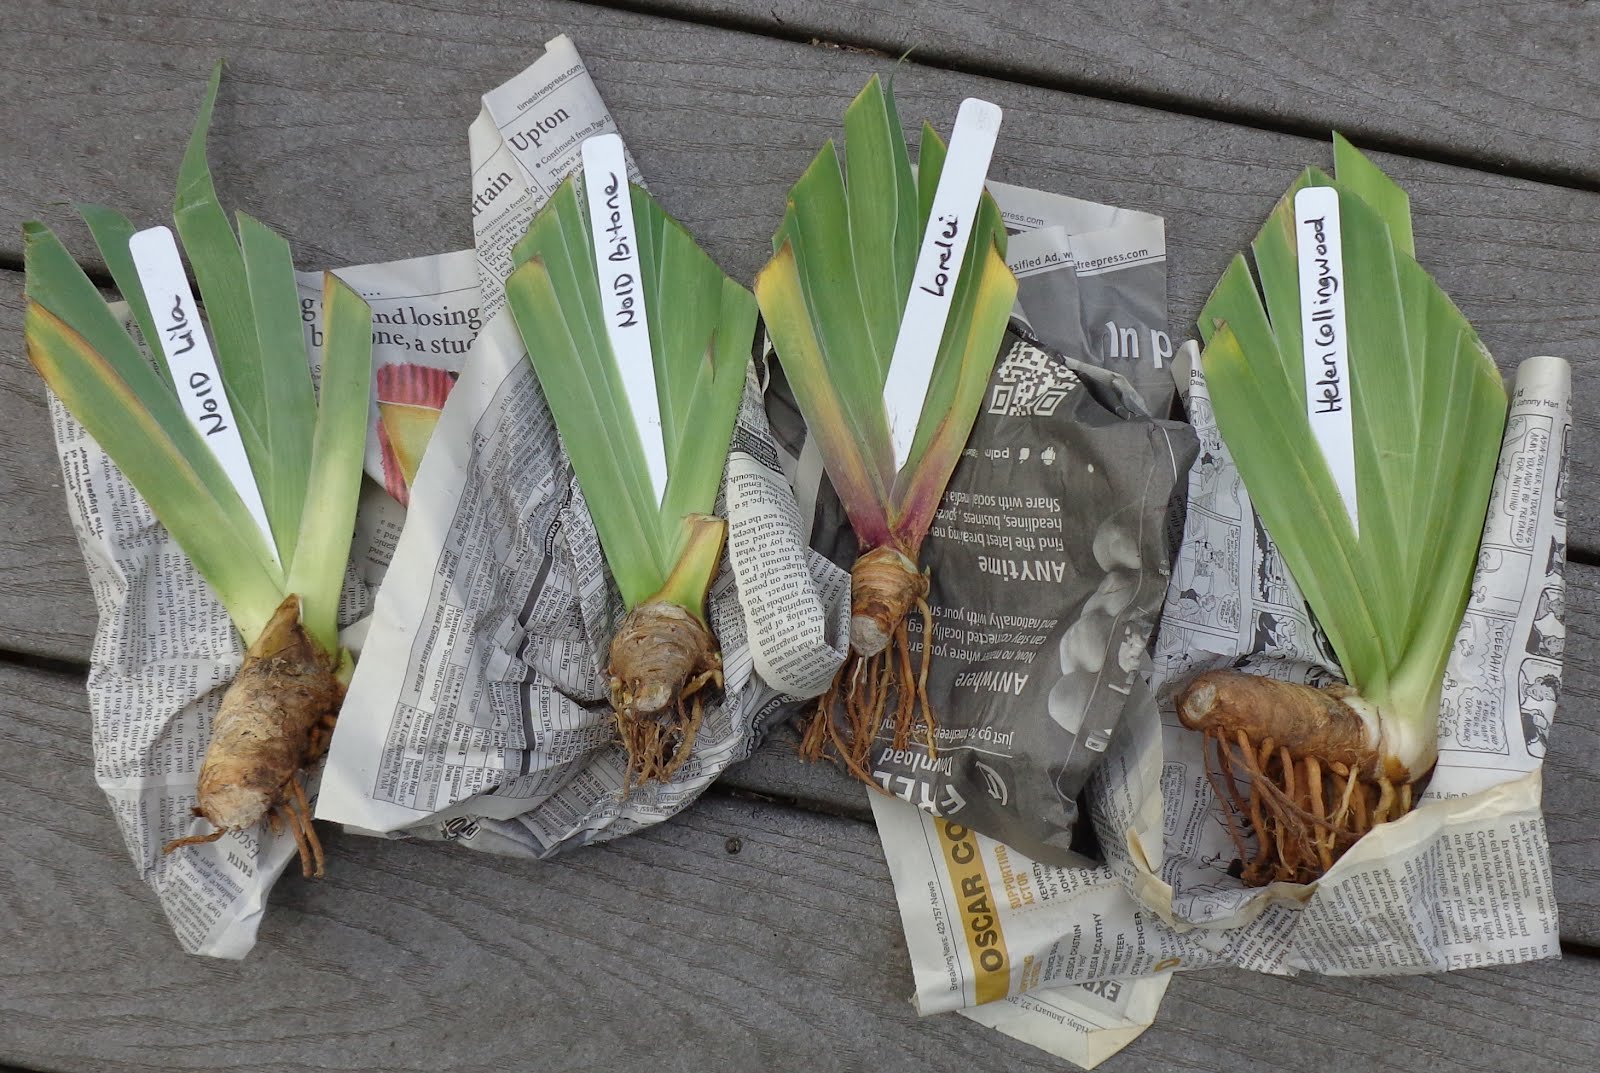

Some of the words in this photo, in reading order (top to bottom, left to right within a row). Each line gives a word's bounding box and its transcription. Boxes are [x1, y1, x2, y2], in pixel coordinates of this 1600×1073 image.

[508, 108, 570, 151] Upton
[541, 136, 576, 164] Continued
[575, 128, 592, 139] from
[549, 156, 575, 177] There's
[476, 208, 510, 237] Continued
[510, 195, 526, 210] from
[506, 225, 517, 234] He
[517, 216, 530, 226] has
[490, 213, 522, 240] performs
[1304, 216, 1338, 346] Collingwood
[614, 273, 638, 327] NOID
[410, 306, 482, 329] losing
[415, 338, 424, 352] a
[1315, 351, 1342, 413] Helen
[189, 372, 228, 436] NOID
[101, 454, 111, 480] works
[106, 483, 114, 499] who
[738, 482, 761, 490] Email
[84, 478, 99, 514] Biggest
[998, 496, 1022, 511] with
[1026, 497, 1060, 513] Share
[732, 520, 747, 530] rest
[758, 523, 774, 531] that
[963, 512, 1000, 530] business
[1003, 514, 1062, 532] headlines,
[733, 528, 756, 539] keeps
[753, 530, 784, 544] created
[770, 537, 783, 547] joy
[987, 533, 1012, 551] latest
[735, 540, 749, 548] can
[758, 543, 767, 552] of
[779, 545, 795, 554] you
[1016, 536, 1035, 551] the
[1038, 537, 1064, 551] Find
[736, 549, 756, 558] what
[738, 556, 757, 567] view
[762, 555, 790, 568] mount
[740, 568, 749, 576] on
[810, 556, 822, 575] more
[978, 556, 1065, 584] ANYtime
[784, 571, 807, 579] these
[165, 571, 174, 608] believing
[198, 580, 208, 608] pretty
[745, 580, 767, 596] poster
[765, 581, 798, 597] impact.
[829, 585, 841, 601] next
[188, 589, 196, 622] Sterling
[748, 596, 763, 606] You
[767, 591, 798, 609] symbols
[778, 598, 814, 614] inspiring
[751, 605, 766, 616] help
[786, 606, 817, 621] catalog
[943, 607, 964, 621] your
[967, 611, 986, 626] with
[447, 608, 464, 646] Shameless
[775, 619, 783, 629] of
[797, 620, 806, 628] or
[990, 612, 1041, 631] nationally
[777, 626, 795, 637] even
[800, 626, 820, 637] from
[759, 635, 776, 647] from
[763, 635, 799, 657] magazines
[797, 640, 814, 652] what
[784, 646, 797, 658] you
[950, 648, 981, 664] where
[156, 664, 166, 677] and
[176, 664, 187, 690] lighter
[955, 670, 1029, 696] ANYwhere
[112, 697, 120, 715] Ron
[123, 686, 133, 710] South
[101, 696, 110, 723] biggest
[133, 707, 143, 722] has
[122, 713, 130, 738] entire
[421, 714, 433, 735] House
[979, 726, 993, 741] go
[130, 725, 141, 750] family
[196, 732, 205, 759] These
[994, 731, 1014, 749] just
[186, 737, 195, 773] journey.
[412, 760, 422, 779] Beach
[408, 780, 418, 796] Heat
[227, 851, 253, 878] FAITH
[1493, 854, 1503, 878] which
[1504, 849, 1513, 870] some
[994, 844, 1022, 909] SUPPORTING
[1031, 862, 1050, 901] KENNETH
[1477, 831, 1488, 861] Certain
[1490, 897, 1505, 940] inherently
[1522, 836, 1533, 857] your
[1539, 916, 1550, 935] you
[1016, 872, 1035, 905] ACTOR
[1351, 874, 1372, 915] Examples
[1399, 876, 1412, 904] Watch
[961, 873, 1004, 972] OSCAR
[1134, 912, 1145, 954] SPENCER
[947, 956, 958, 991] Breaking
[1033, 1004, 1065, 1025] January
